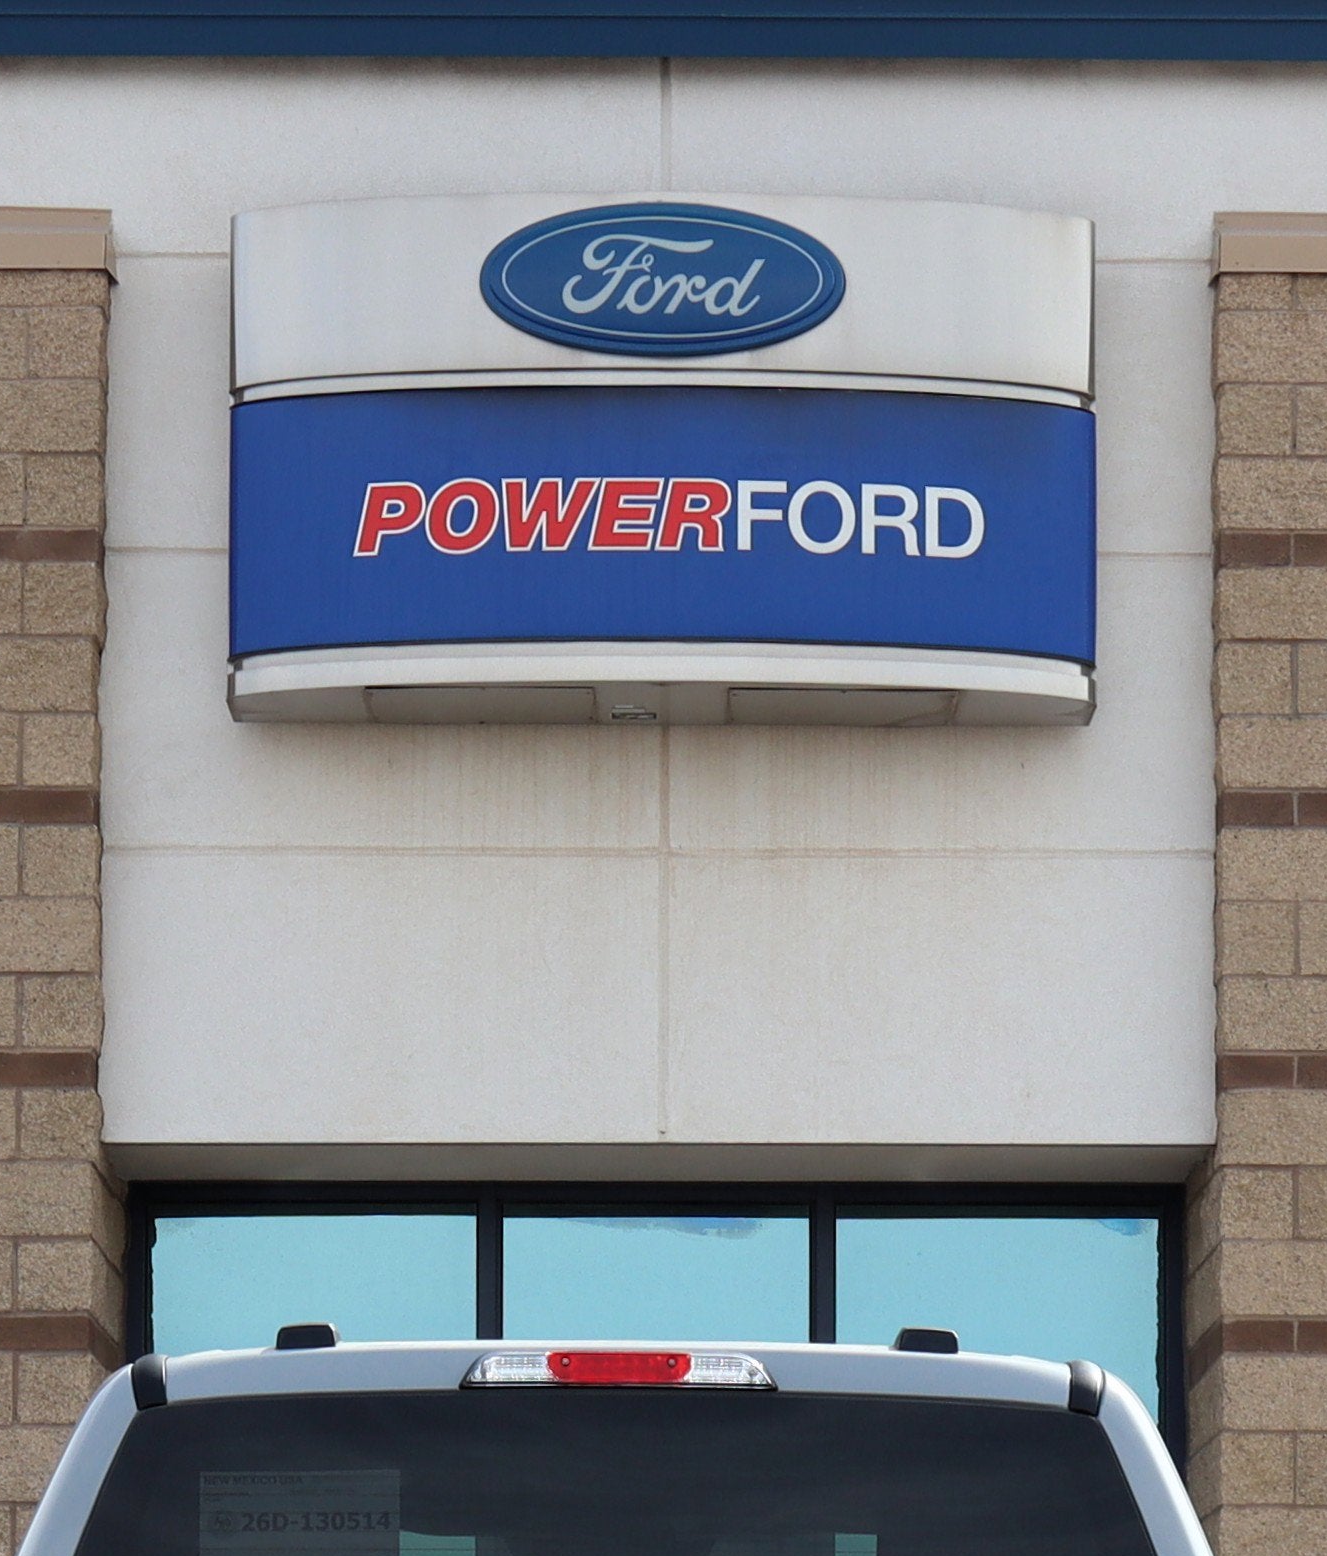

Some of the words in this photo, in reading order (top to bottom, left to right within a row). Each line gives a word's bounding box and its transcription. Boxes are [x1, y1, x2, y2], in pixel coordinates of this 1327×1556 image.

[562, 233, 765, 317] Ford
[353, 476, 986, 558] POWERFORD
[242, 1511, 391, 1532] 26D-130514
